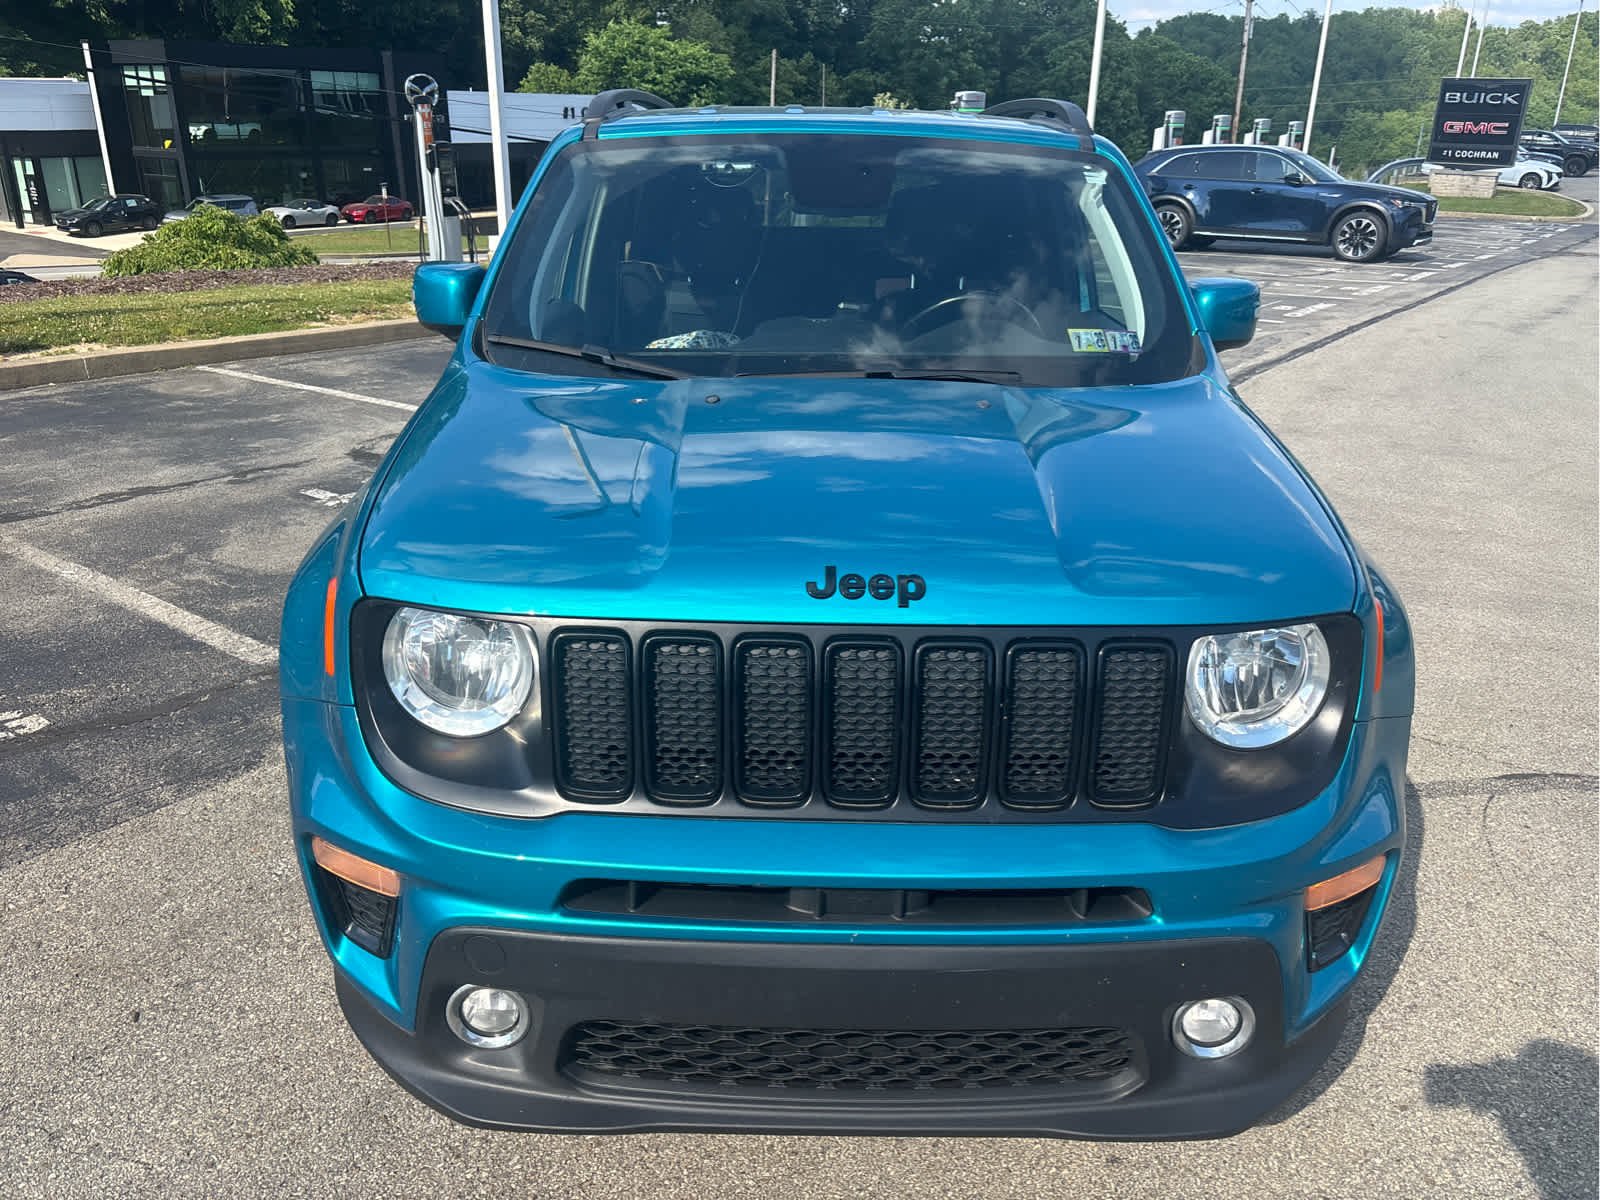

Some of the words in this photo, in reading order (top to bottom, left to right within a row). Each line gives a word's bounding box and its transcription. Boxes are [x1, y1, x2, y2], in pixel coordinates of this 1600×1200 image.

[1444, 92, 1521, 105] BUICK
[1443, 121, 1510, 135] GMC
[1455, 150, 1500, 160] COCHRAN
[805, 565, 927, 608] Jeep
